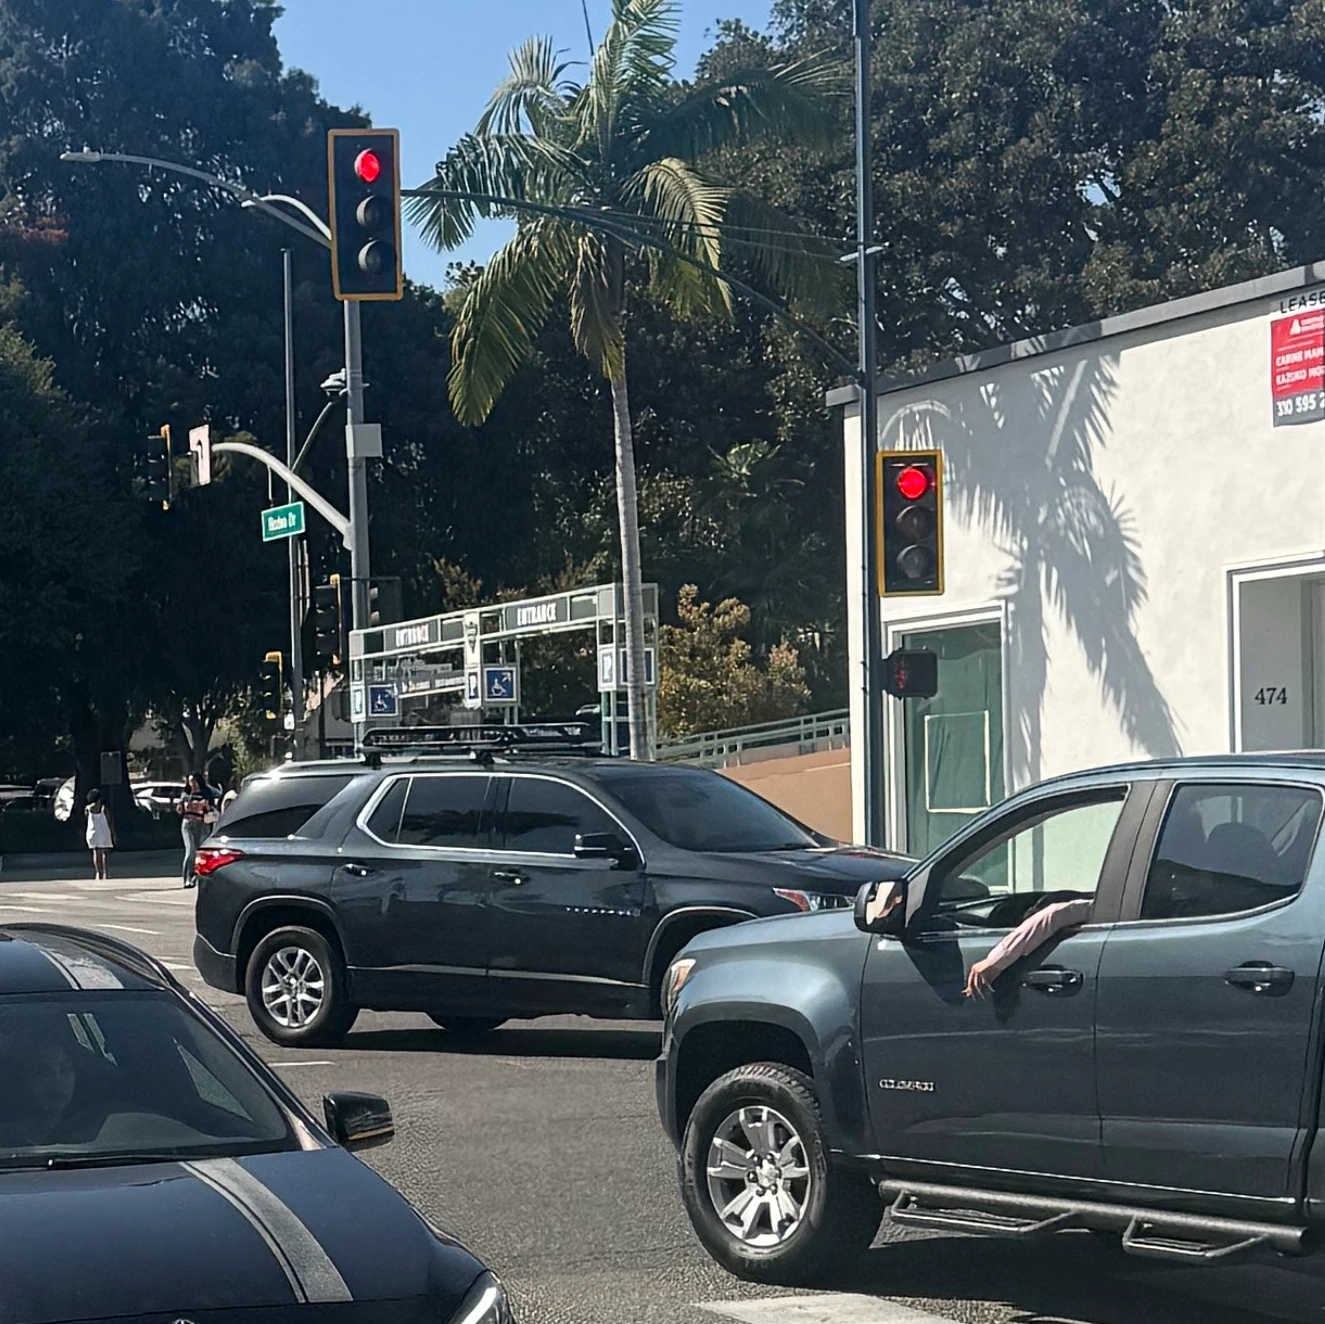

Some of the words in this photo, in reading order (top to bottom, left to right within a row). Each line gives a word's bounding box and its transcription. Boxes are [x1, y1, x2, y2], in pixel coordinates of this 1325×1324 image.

[1276, 398, 1293, 417] 310
[1296, 394, 1316, 413] 595
[517, 602, 556, 626] ENTRANCE
[1254, 687, 1287, 705] 474
